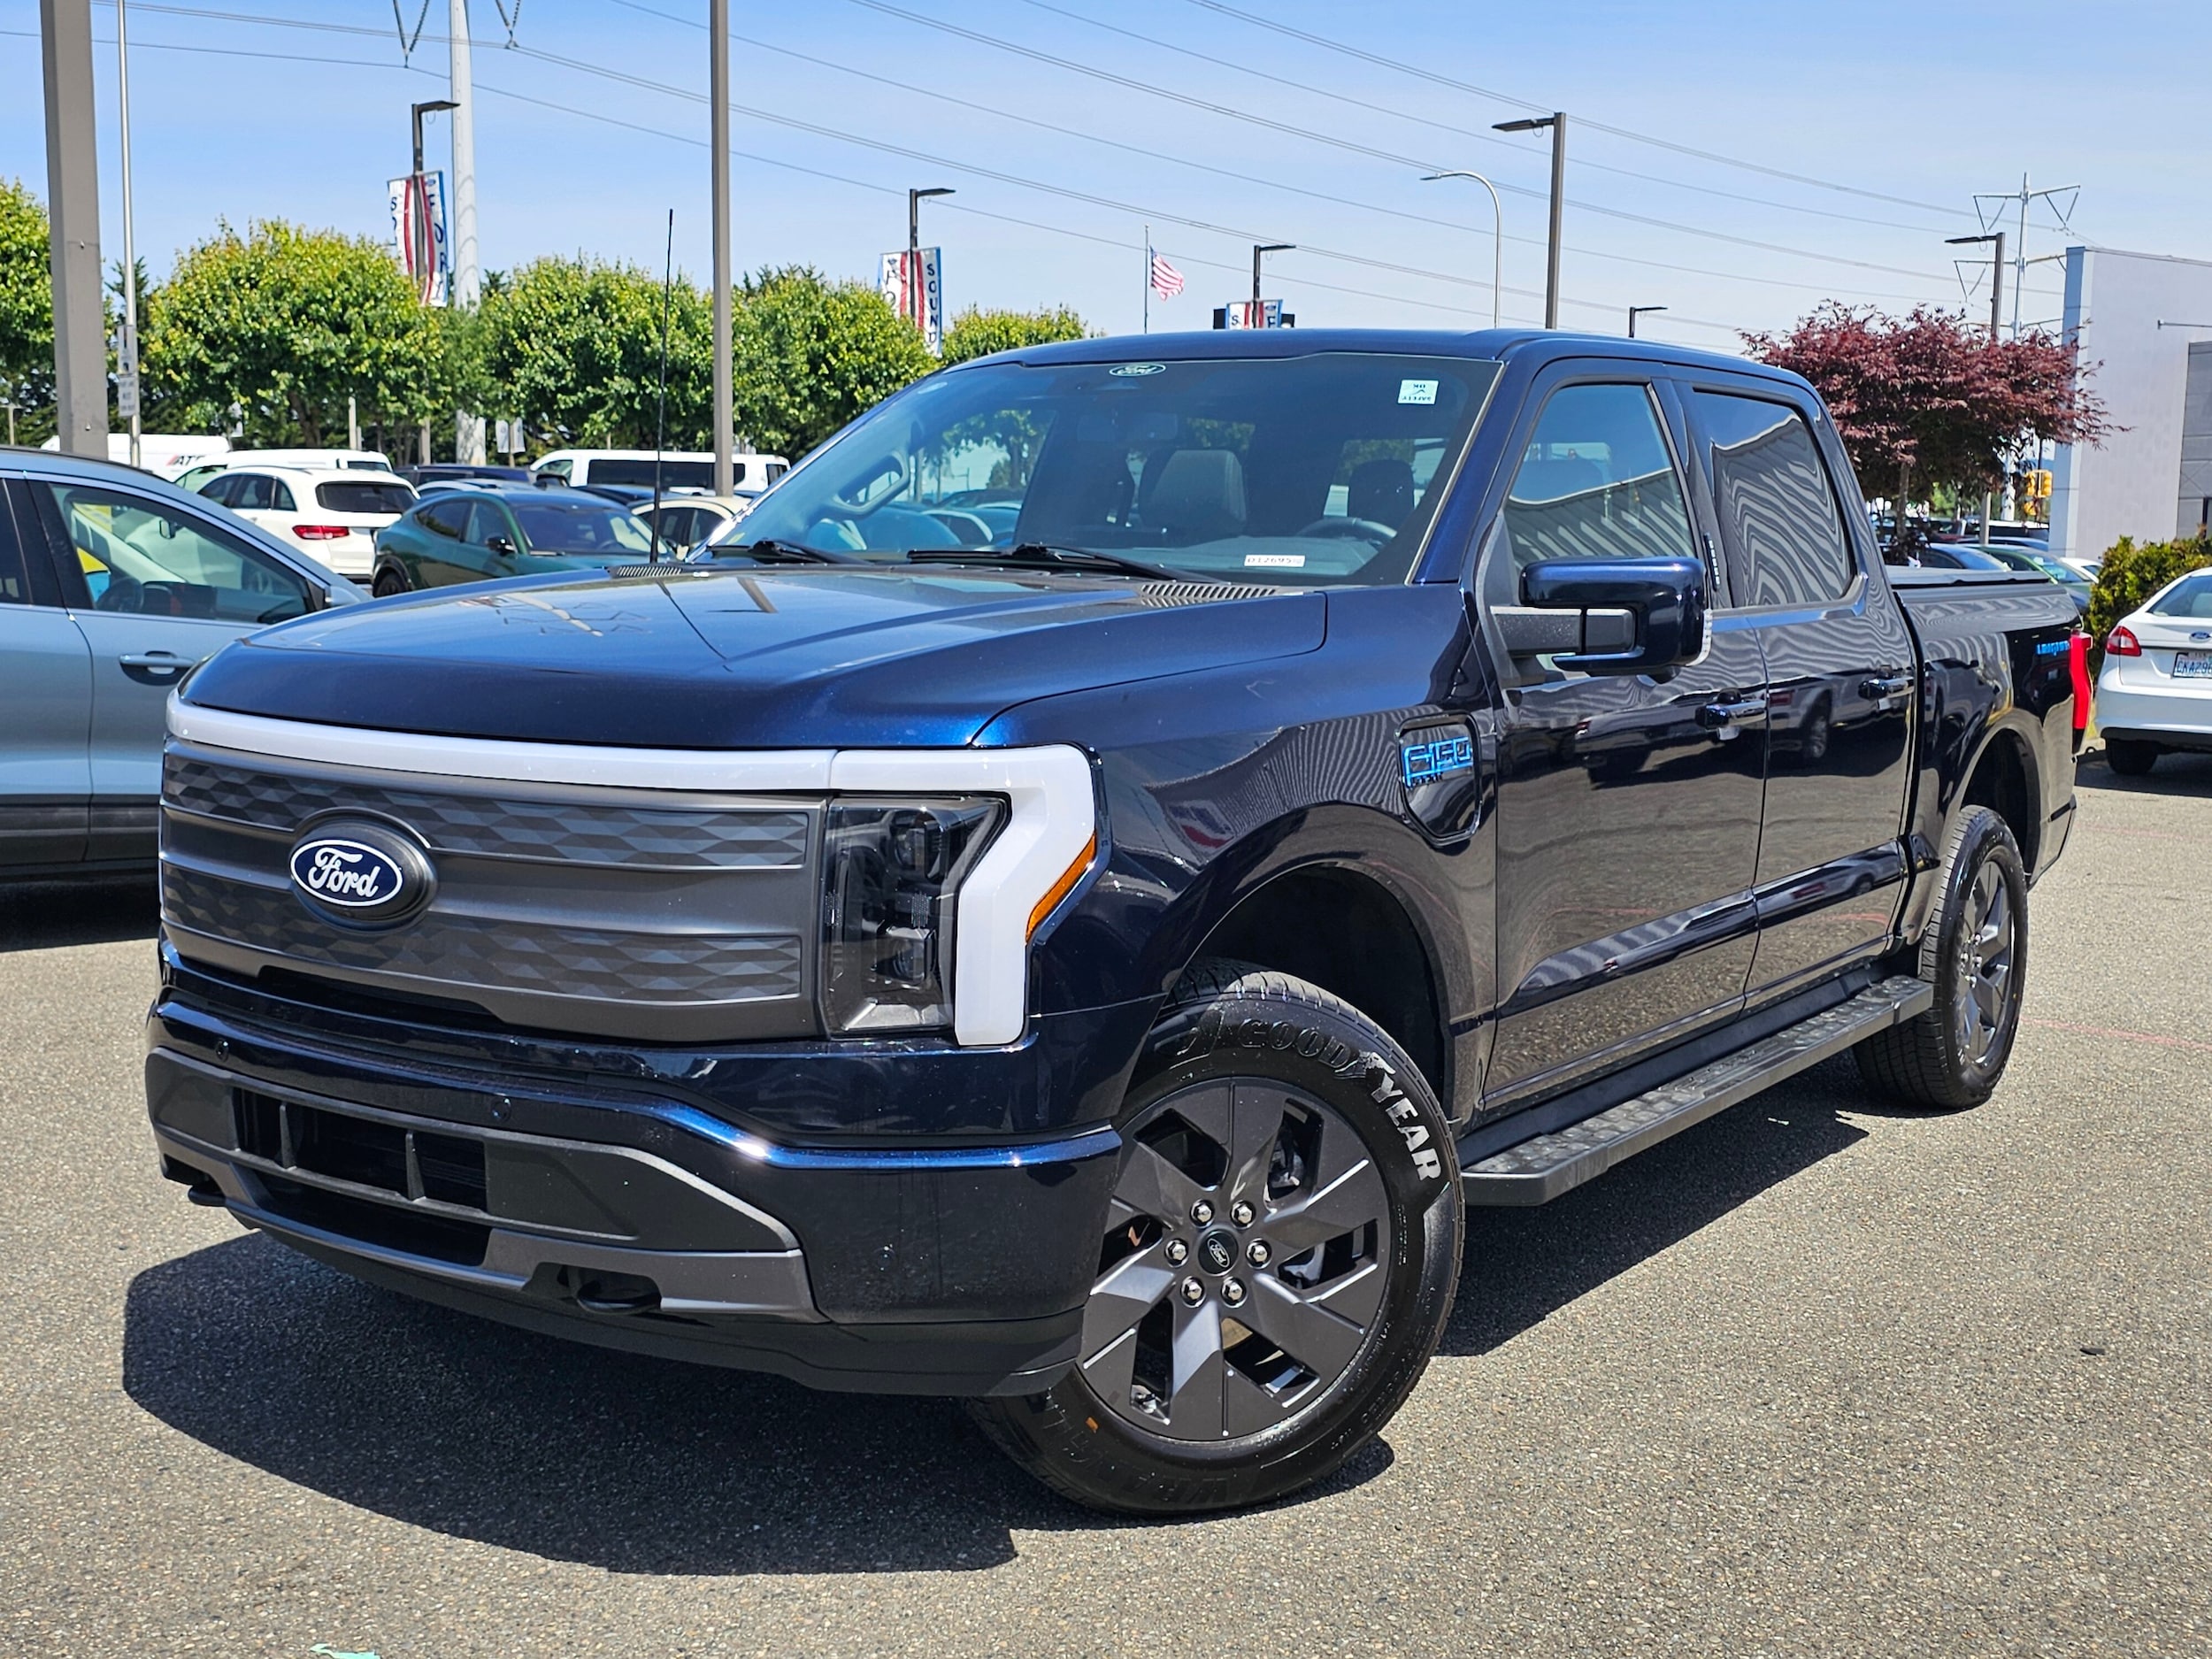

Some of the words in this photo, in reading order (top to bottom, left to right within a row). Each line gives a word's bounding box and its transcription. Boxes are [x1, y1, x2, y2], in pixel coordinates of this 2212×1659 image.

[926, 263, 939, 344] SOUND
[308, 847, 381, 898] Ford
[1210, 1243, 1227, 1263] Ford
